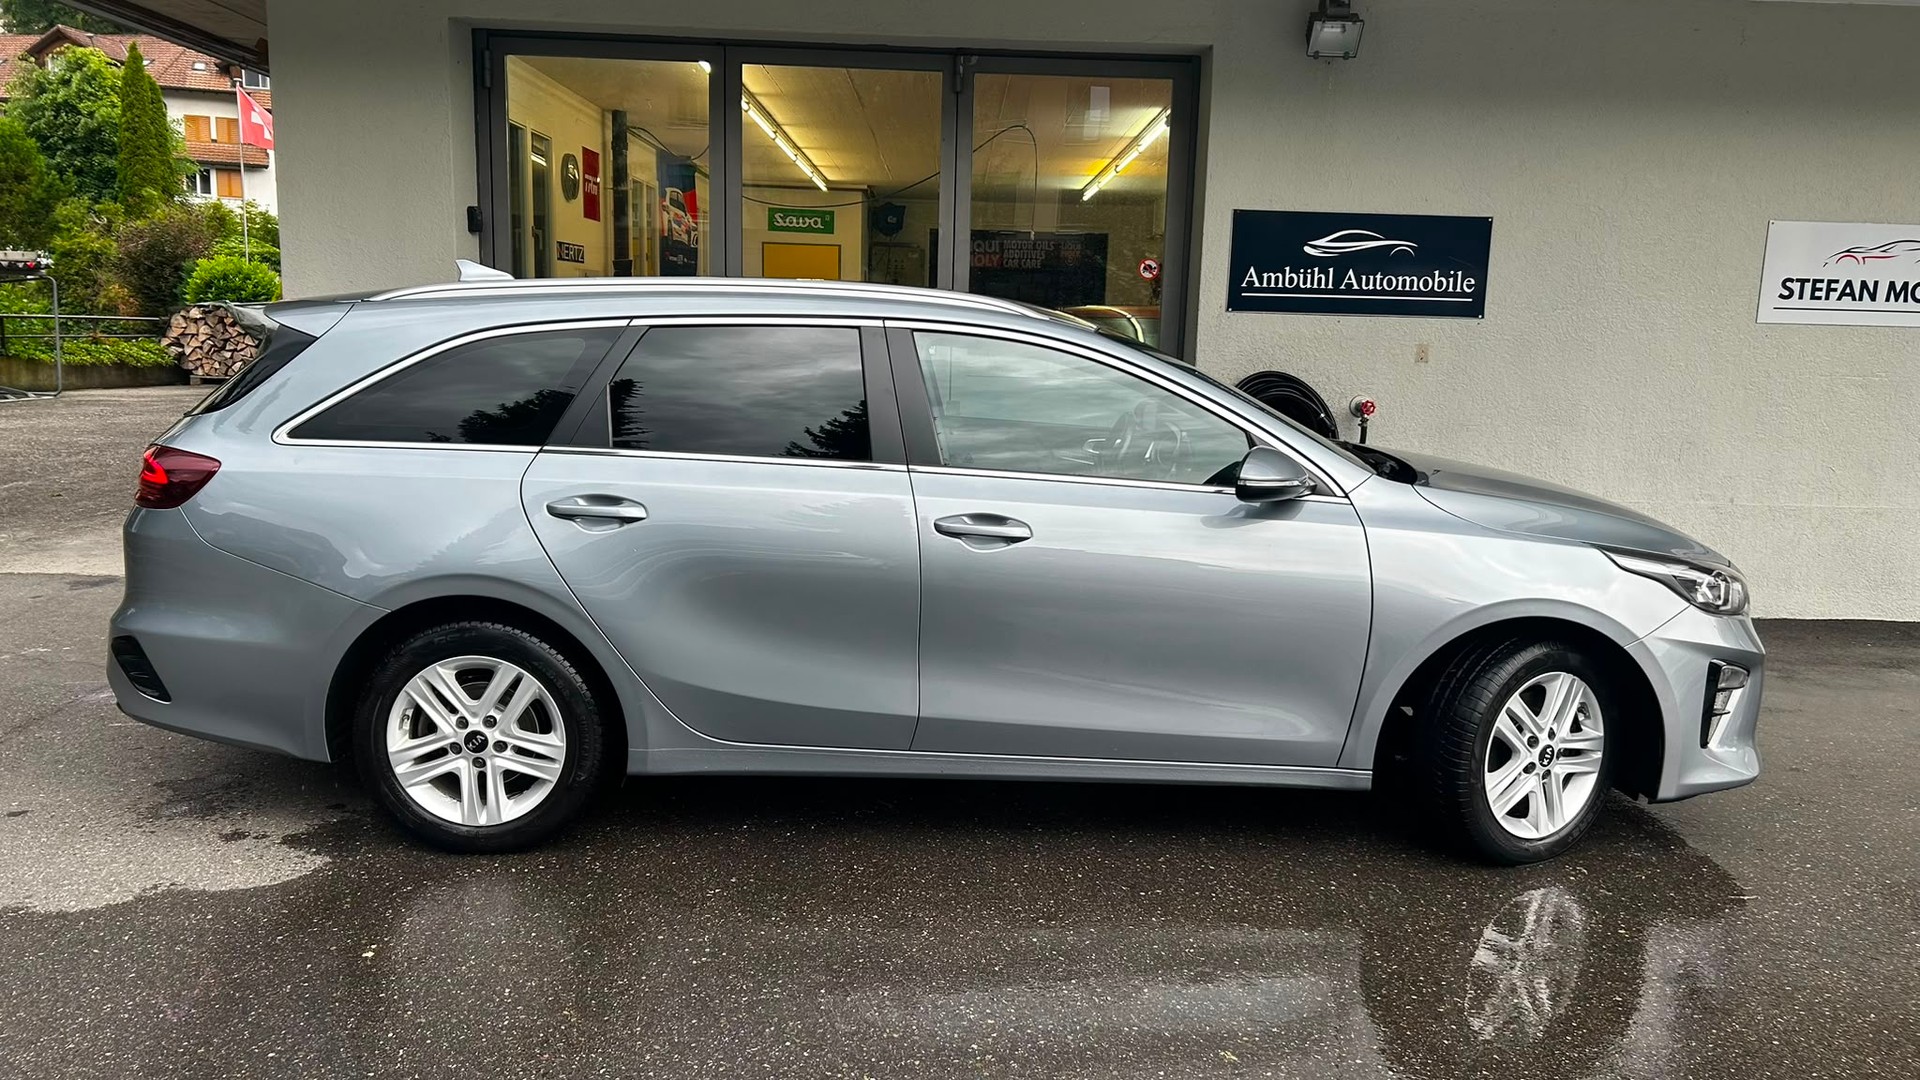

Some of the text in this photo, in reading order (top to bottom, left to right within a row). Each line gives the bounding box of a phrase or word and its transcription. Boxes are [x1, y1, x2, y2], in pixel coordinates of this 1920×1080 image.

[774, 212, 824, 229] Sava
[1003, 240, 1034, 250] MOTOR
[1036, 241, 1055, 251] OILS
[1003, 250, 1046, 259] ADDITIVES
[1003, 259, 1042, 269] CAR CARE
[1240, 266, 1476, 293] Ambühl Automobile
[1778, 277, 1880, 302] STEFAN
[466, 735, 485, 750] KIA
[1542, 747, 1553, 765] KIA
